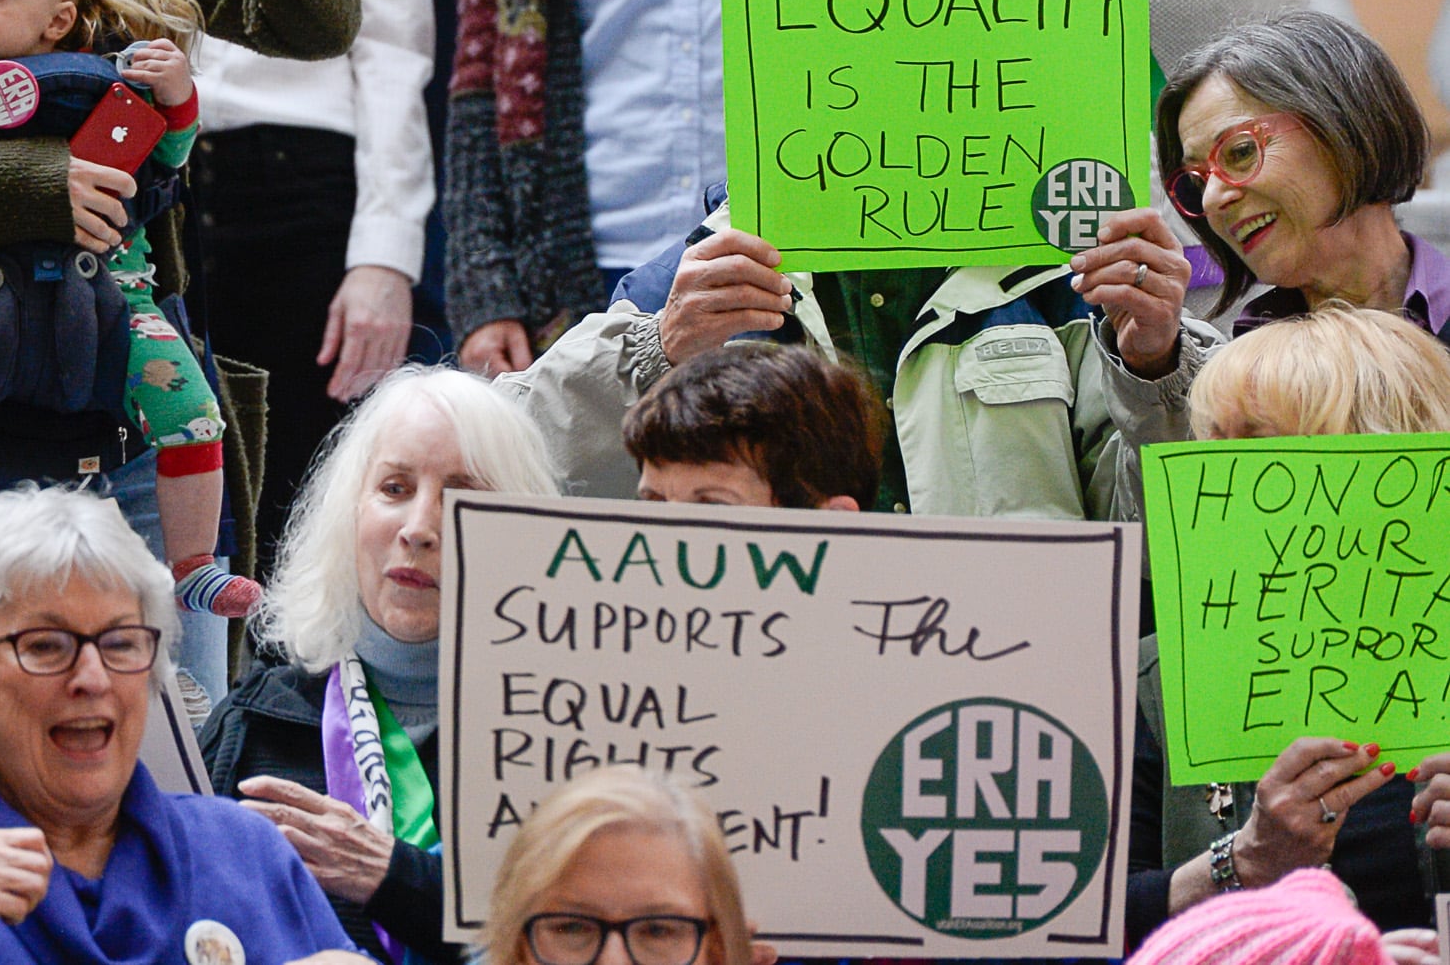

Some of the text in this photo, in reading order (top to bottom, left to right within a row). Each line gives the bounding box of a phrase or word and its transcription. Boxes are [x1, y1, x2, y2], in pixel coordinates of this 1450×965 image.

[806, 57, 1037, 114] IS THE
[776, 126, 1046, 192] GOLDEN
[1047, 160, 1121, 207] ERA
[853, 182, 1017, 241] RULE
[1038, 210, 1118, 248] YE
[545, 527, 830, 596] AAUW
[1263, 519, 1428, 580] YOUR
[489, 585, 1032, 661] SUPPORTS The
[501, 671, 718, 731] EQUAL
[902, 704, 1074, 820] ERA
[878, 828, 1082, 920] YES
